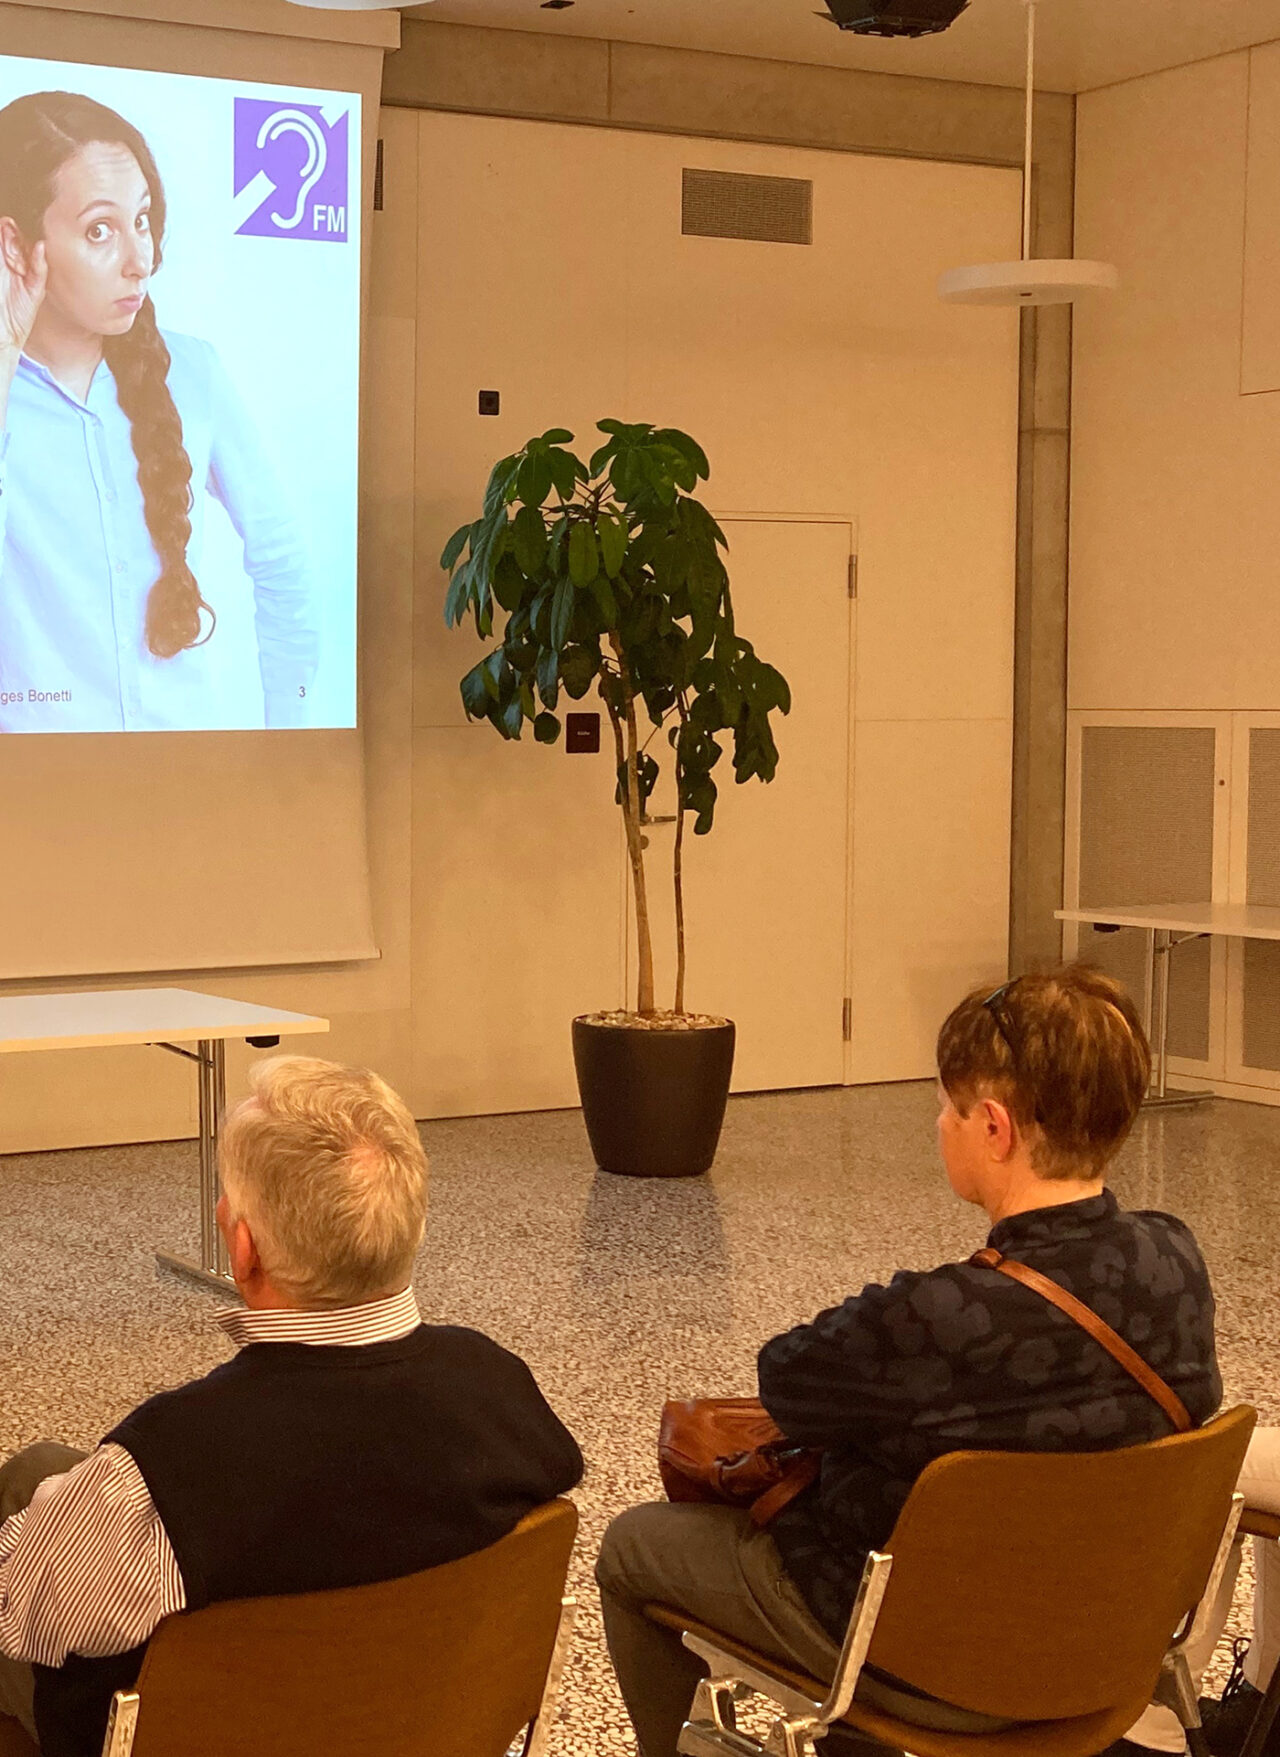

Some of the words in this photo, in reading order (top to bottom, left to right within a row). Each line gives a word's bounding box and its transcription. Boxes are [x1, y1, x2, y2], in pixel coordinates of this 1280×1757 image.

[313, 204, 345, 233] FM
[28, 689, 73, 704] Bonetti
[299, 686, 306, 698] 3
